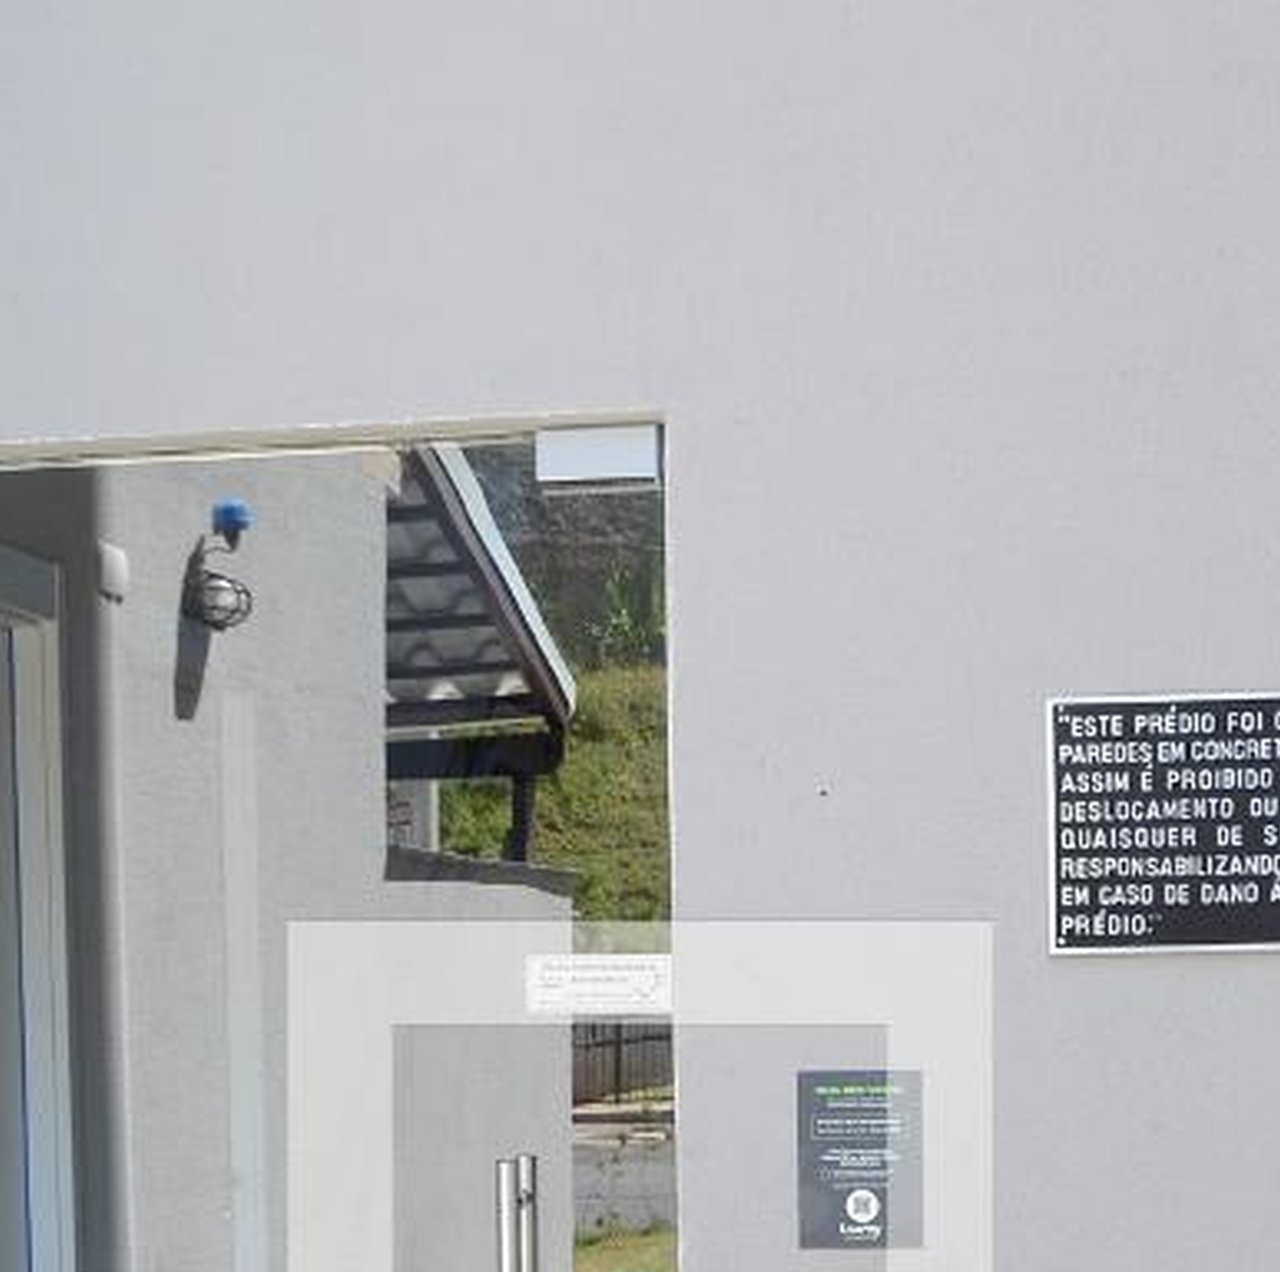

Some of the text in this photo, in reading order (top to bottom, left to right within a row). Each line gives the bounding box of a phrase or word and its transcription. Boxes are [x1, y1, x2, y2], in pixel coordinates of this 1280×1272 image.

[1134, 705, 1216, 735] PRÉDIO
[1227, 711, 1263, 733] FOI
[1058, 742, 1153, 764] PAREDES
[1157, 741, 1186, 763] EM
[1060, 770, 1130, 793] ASSIM
[1141, 763, 1153, 792] É
[1167, 767, 1273, 791] PROIBIDO
[1060, 797, 1234, 822] DESLOCAMENTO
[1250, 796, 1279, 817] OU
[1060, 827, 1197, 850] QUAISQUER
[1217, 825, 1243, 847] DE
[1061, 884, 1090, 906] EM
[1098, 883, 1153, 905] CASO
[1164, 883, 1190, 905] DE
[1201, 882, 1259, 905] DANO
